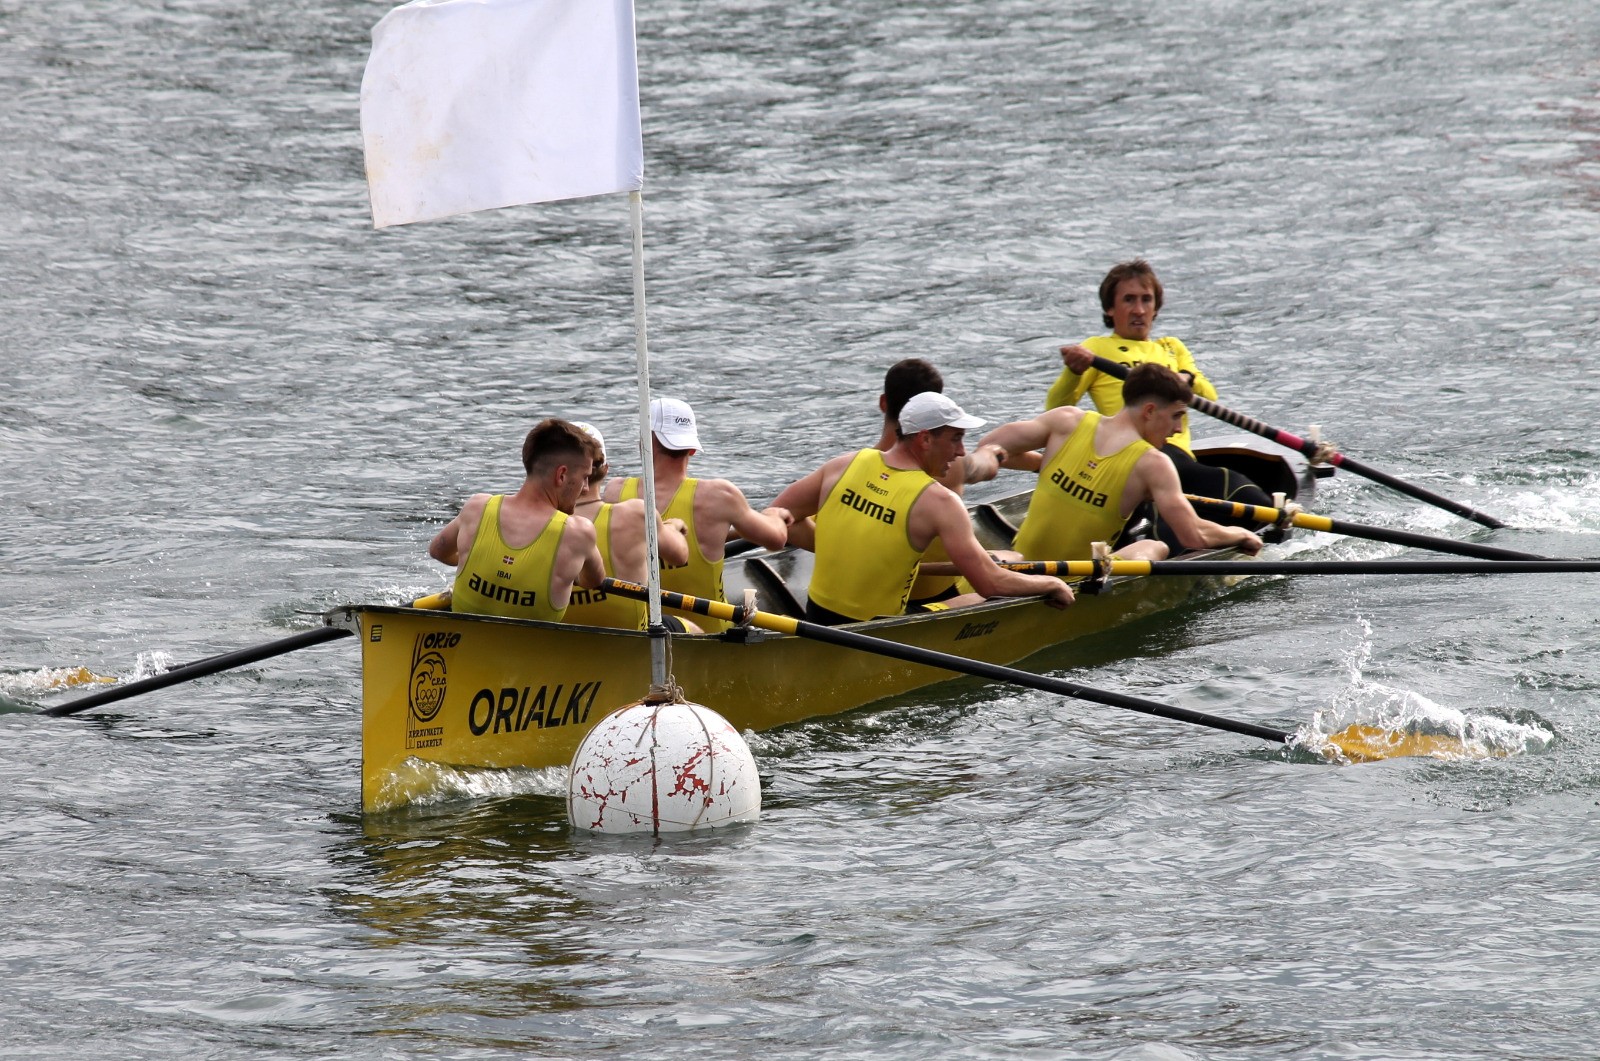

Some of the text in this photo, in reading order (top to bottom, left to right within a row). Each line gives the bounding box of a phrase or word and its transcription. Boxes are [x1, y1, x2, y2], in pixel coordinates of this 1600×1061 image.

[1050, 468, 1109, 508] auma
[840, 488, 897, 525] auma
[468, 572, 536, 607] auma
[496, 569, 512, 580] IBAI
[569, 588, 607, 606] ma
[468, 680, 602, 737] ORIALKI
